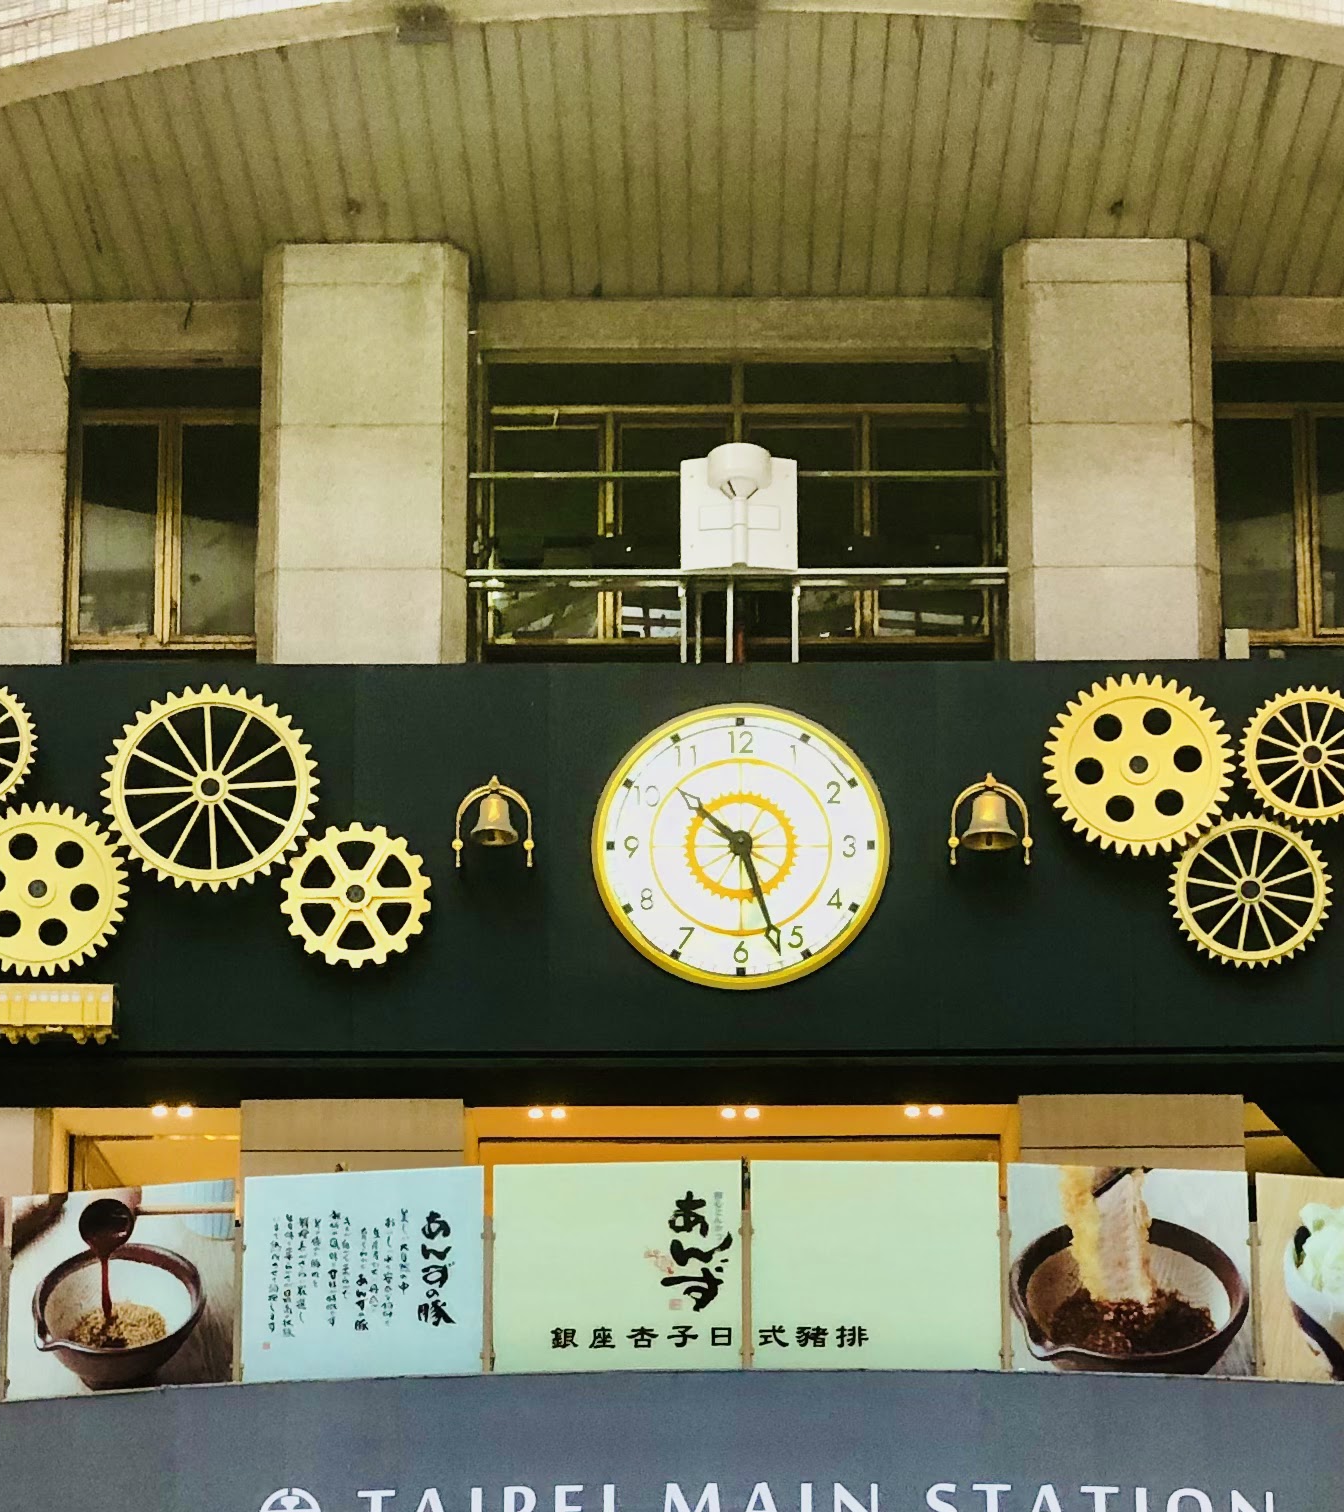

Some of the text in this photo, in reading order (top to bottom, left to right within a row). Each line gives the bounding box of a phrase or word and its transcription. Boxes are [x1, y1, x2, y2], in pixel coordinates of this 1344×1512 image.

[728, 730, 754, 754] 12
[674, 744, 698, 768] 11
[633, 784, 661, 807] 10
[826, 780, 841, 804] 2
[623, 835, 640, 859] 9
[842, 835, 856, 858] 3
[640, 888, 654, 910] 8
[826, 888, 843, 910] 4
[678, 926, 696, 950] 7
[787, 925, 804, 949] 5
[733, 940, 749, 964] 6
[660, 1190, 733, 1313] あんず
[417, 1210, 456, 1327] あんずの豚
